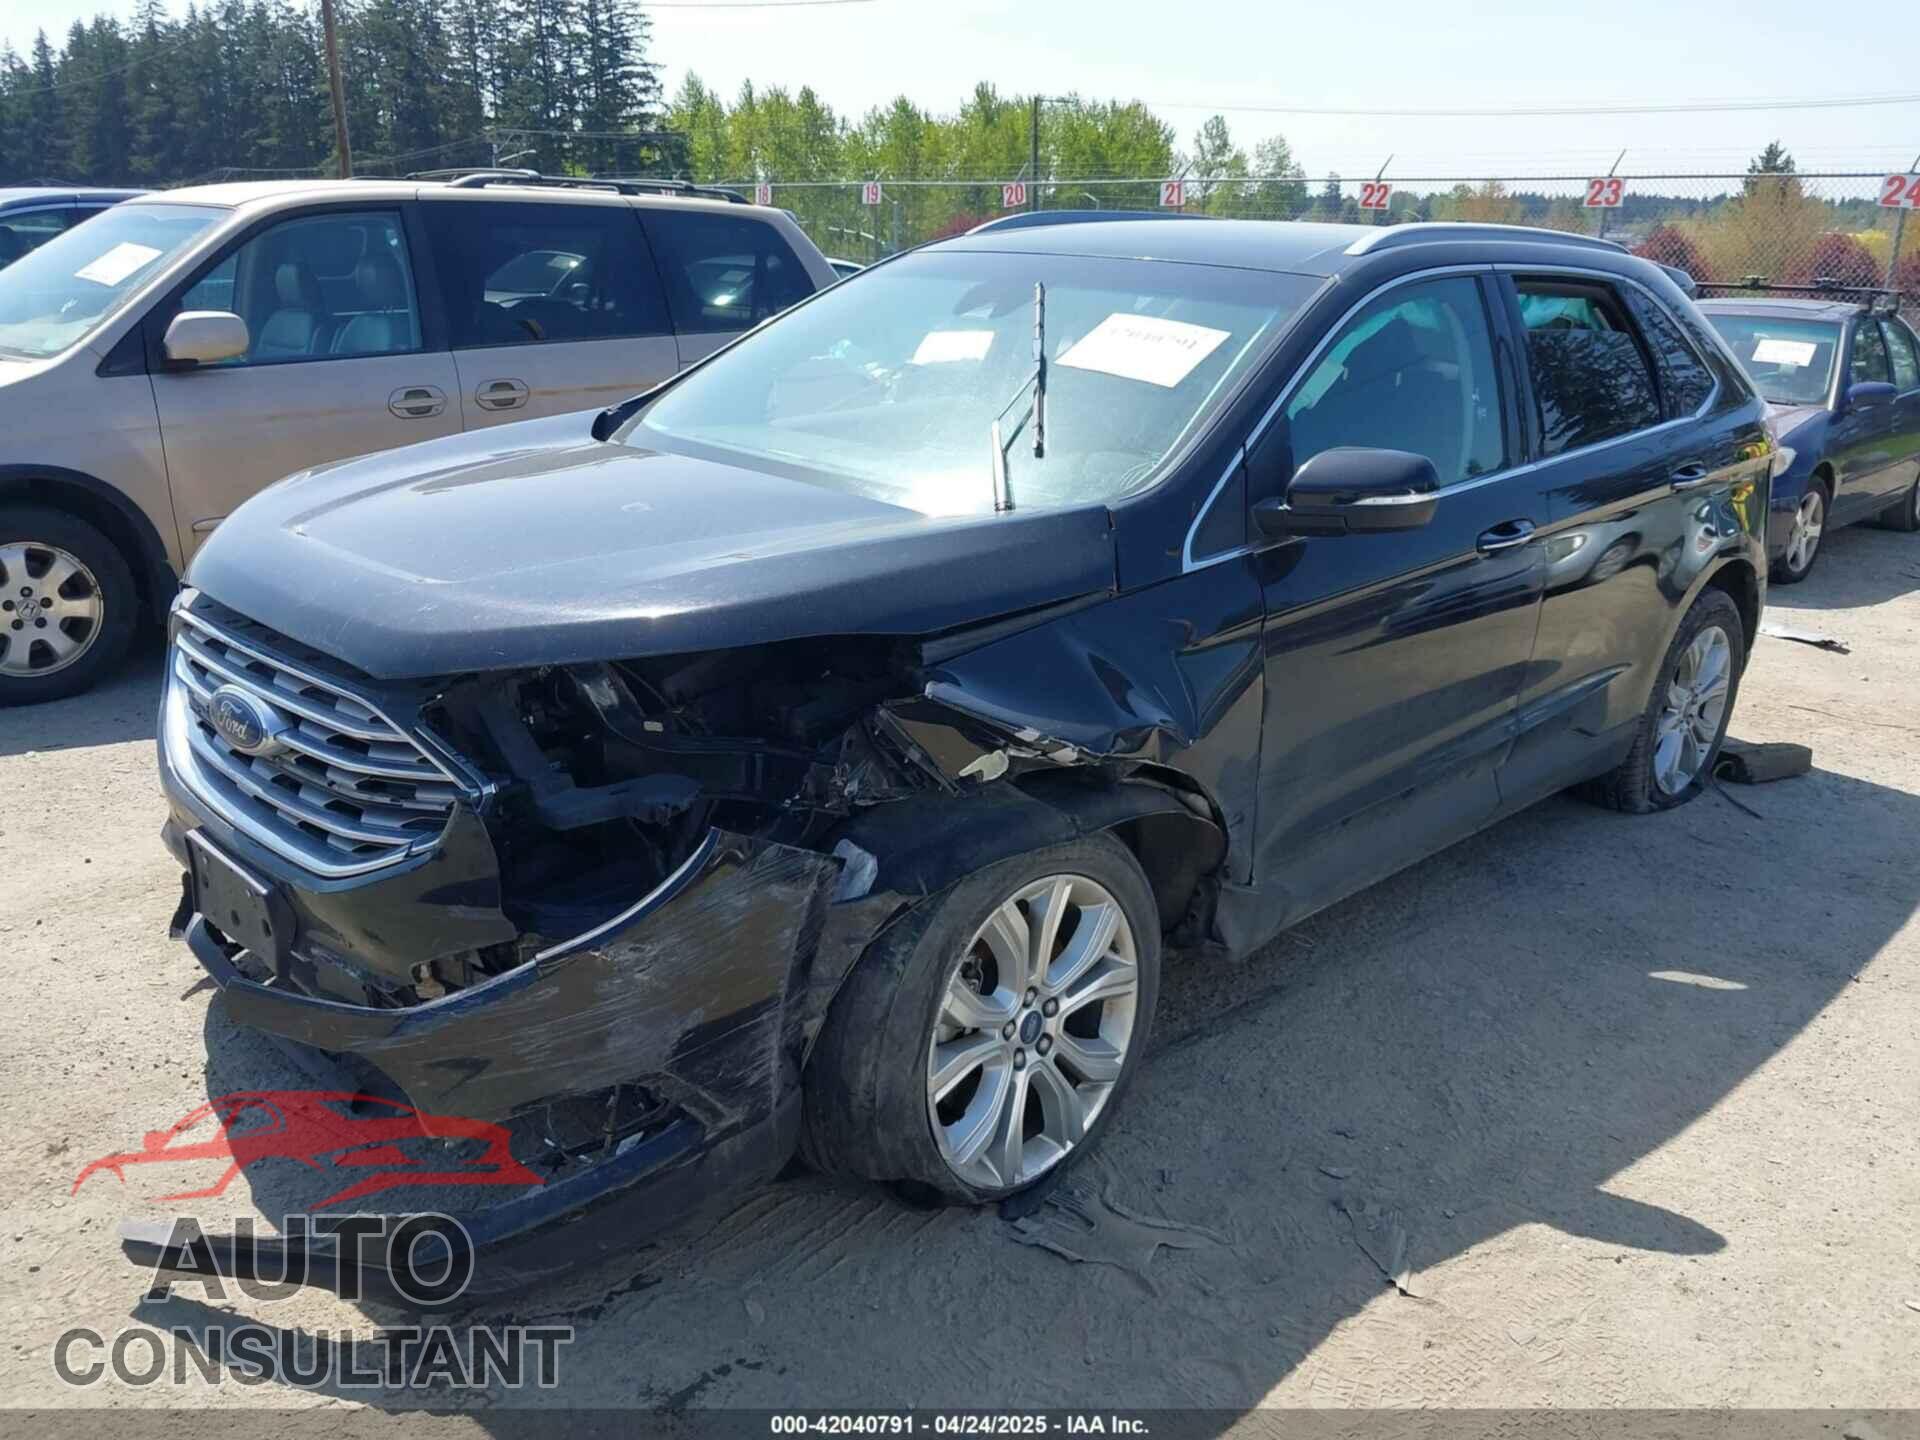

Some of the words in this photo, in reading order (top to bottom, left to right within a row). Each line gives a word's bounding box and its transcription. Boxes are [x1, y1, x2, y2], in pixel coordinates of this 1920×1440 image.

[759, 185, 769, 204] 18
[867, 183, 879, 205] 19
[1005, 184, 1024, 206] 20
[1164, 183, 1182, 205] 21
[1361, 183, 1388, 208] 22
[1587, 179, 1621, 206] 23
[1881, 175, 1920, 207] 24
[216, 700, 249, 740] Ford
